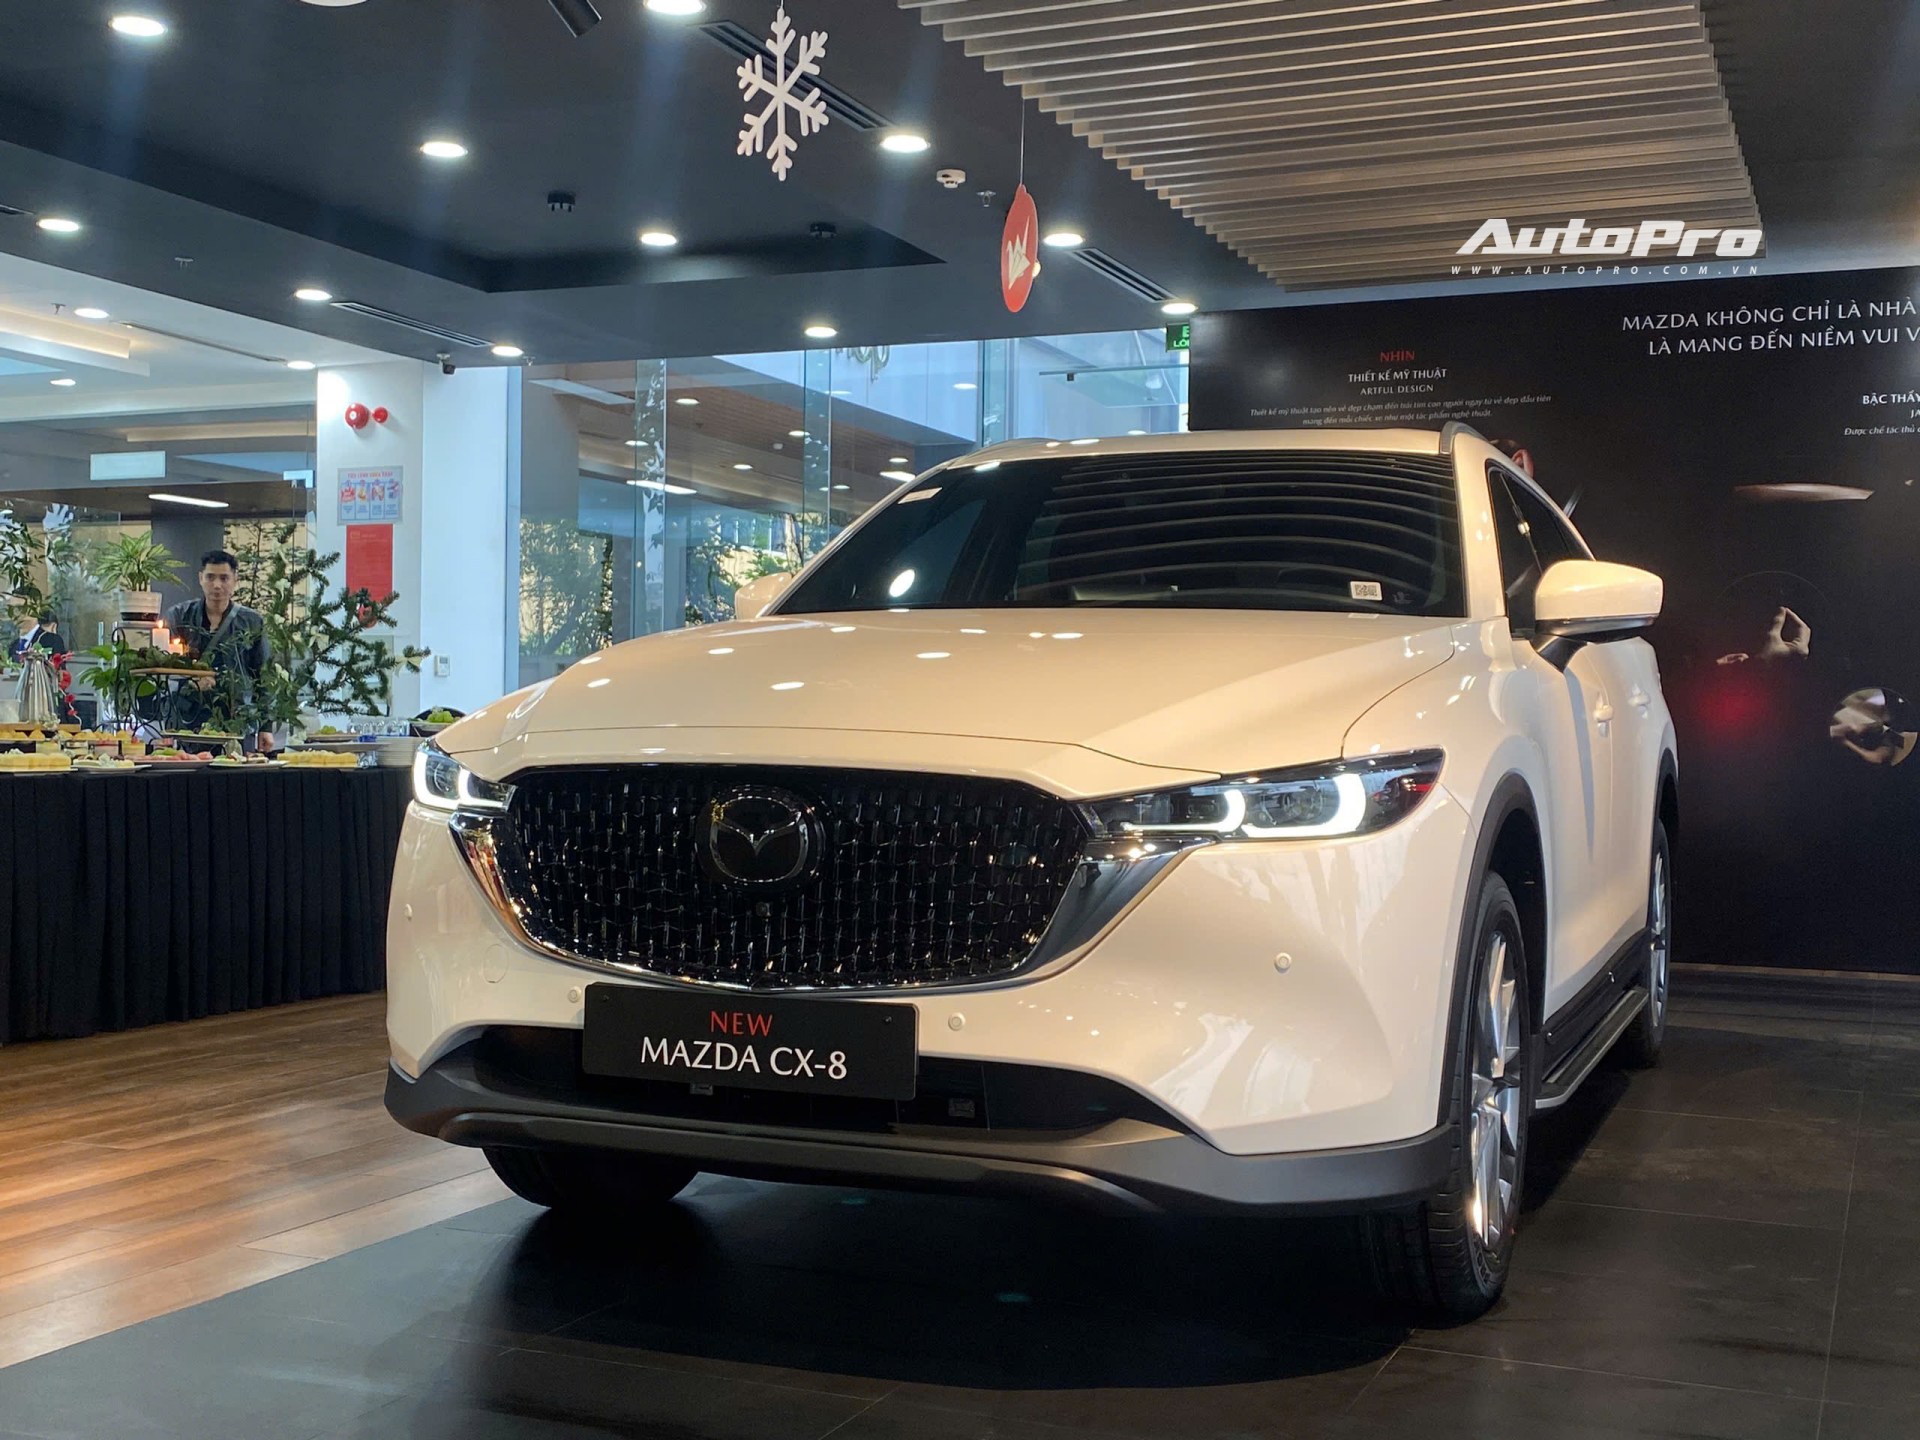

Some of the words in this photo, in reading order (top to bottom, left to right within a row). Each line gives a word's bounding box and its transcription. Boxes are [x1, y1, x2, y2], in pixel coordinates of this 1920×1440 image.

[1622, 313, 1699, 331] MAZDA
[1707, 306, 1784, 326] KHÔNG
[1792, 300, 1830, 321] CHỈ
[1839, 299, 1861, 319] LÀ
[1869, 296, 1917, 317] NHÀ
[1649, 336, 1672, 355] LÀ
[1678, 336, 1743, 354] MANG
[1750, 328, 1793, 350] ĐẾN
[1801, 325, 1856, 348] NIỀM
[1862, 327, 1898, 344] VUI
[1348, 369, 1376, 383] THIẾT
[1378, 368, 1392, 381] KẾ
[1393, 368, 1410, 380] MỸ
[1413, 366, 1447, 380] THUẬT
[1360, 386, 1394, 395] ARTFUL
[1397, 384, 1434, 394] DESIGN
[1862, 392, 1888, 406] BẬC
[1844, 427, 1867, 436] Được
[1869, 425, 1885, 435] chế
[710, 1010, 773, 1037] NEW
[640, 1036, 760, 1073] MAZDA
[770, 1046, 848, 1080] CX-8
